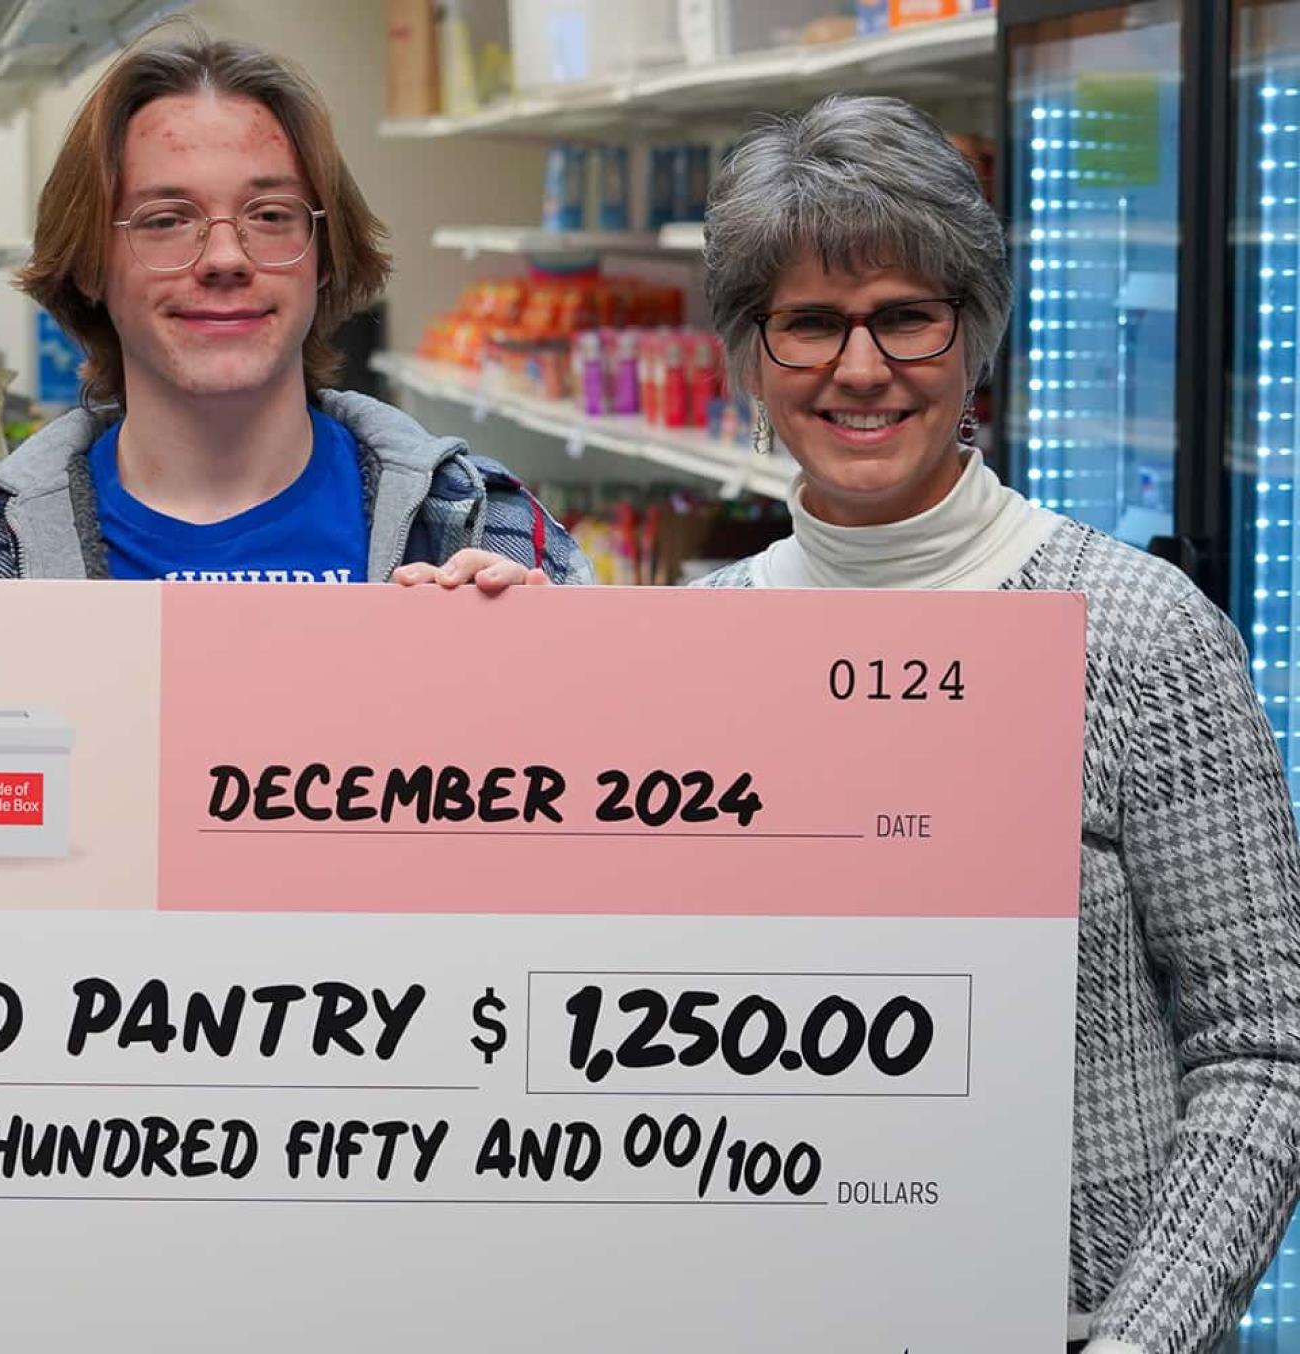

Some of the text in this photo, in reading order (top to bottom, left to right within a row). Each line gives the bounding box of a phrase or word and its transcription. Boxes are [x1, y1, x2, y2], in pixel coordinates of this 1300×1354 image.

[830, 659, 964, 700] 0124
[16, 782, 29, 796] of
[209, 763, 762, 826] DECEMBER 2024
[14, 799, 38, 812] Box
[877, 815, 930, 837] DATE
[67, 978, 425, 1060] PANTRY
[471, 987, 506, 1064] $
[566, 986, 933, 1082] 1,250.00
[286, 1120, 448, 1182] FIFTY
[476, 1118, 601, 1181] AND
[624, 1114, 821, 1198] 00/100
[838, 1182, 938, 1204] DOLLARS
